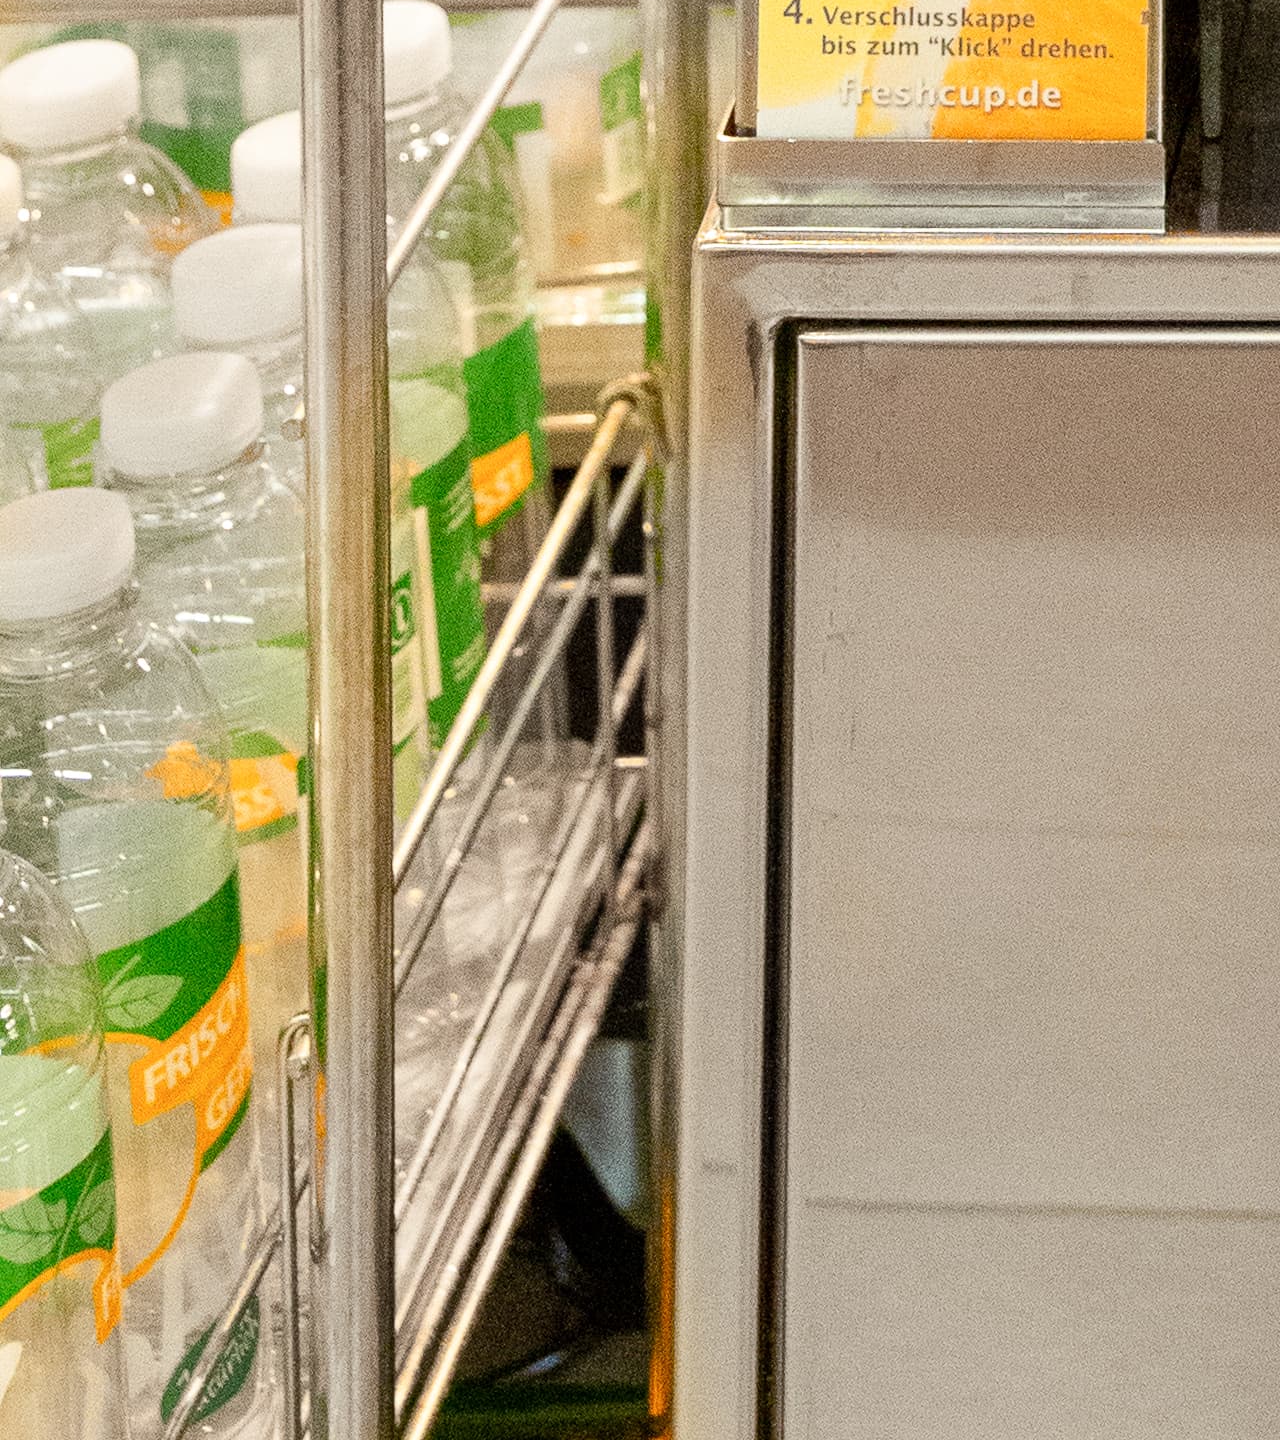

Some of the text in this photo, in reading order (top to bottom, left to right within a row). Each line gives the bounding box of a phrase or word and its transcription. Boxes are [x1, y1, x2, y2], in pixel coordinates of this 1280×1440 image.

[823, 6, 1035, 32] Verschlusskappe
[822, 36, 856, 55] bis
[867, 40, 919, 56] zum
[1021, 38, 1114, 59] drehen.
[840, 76, 1062, 112] freshcup.de
